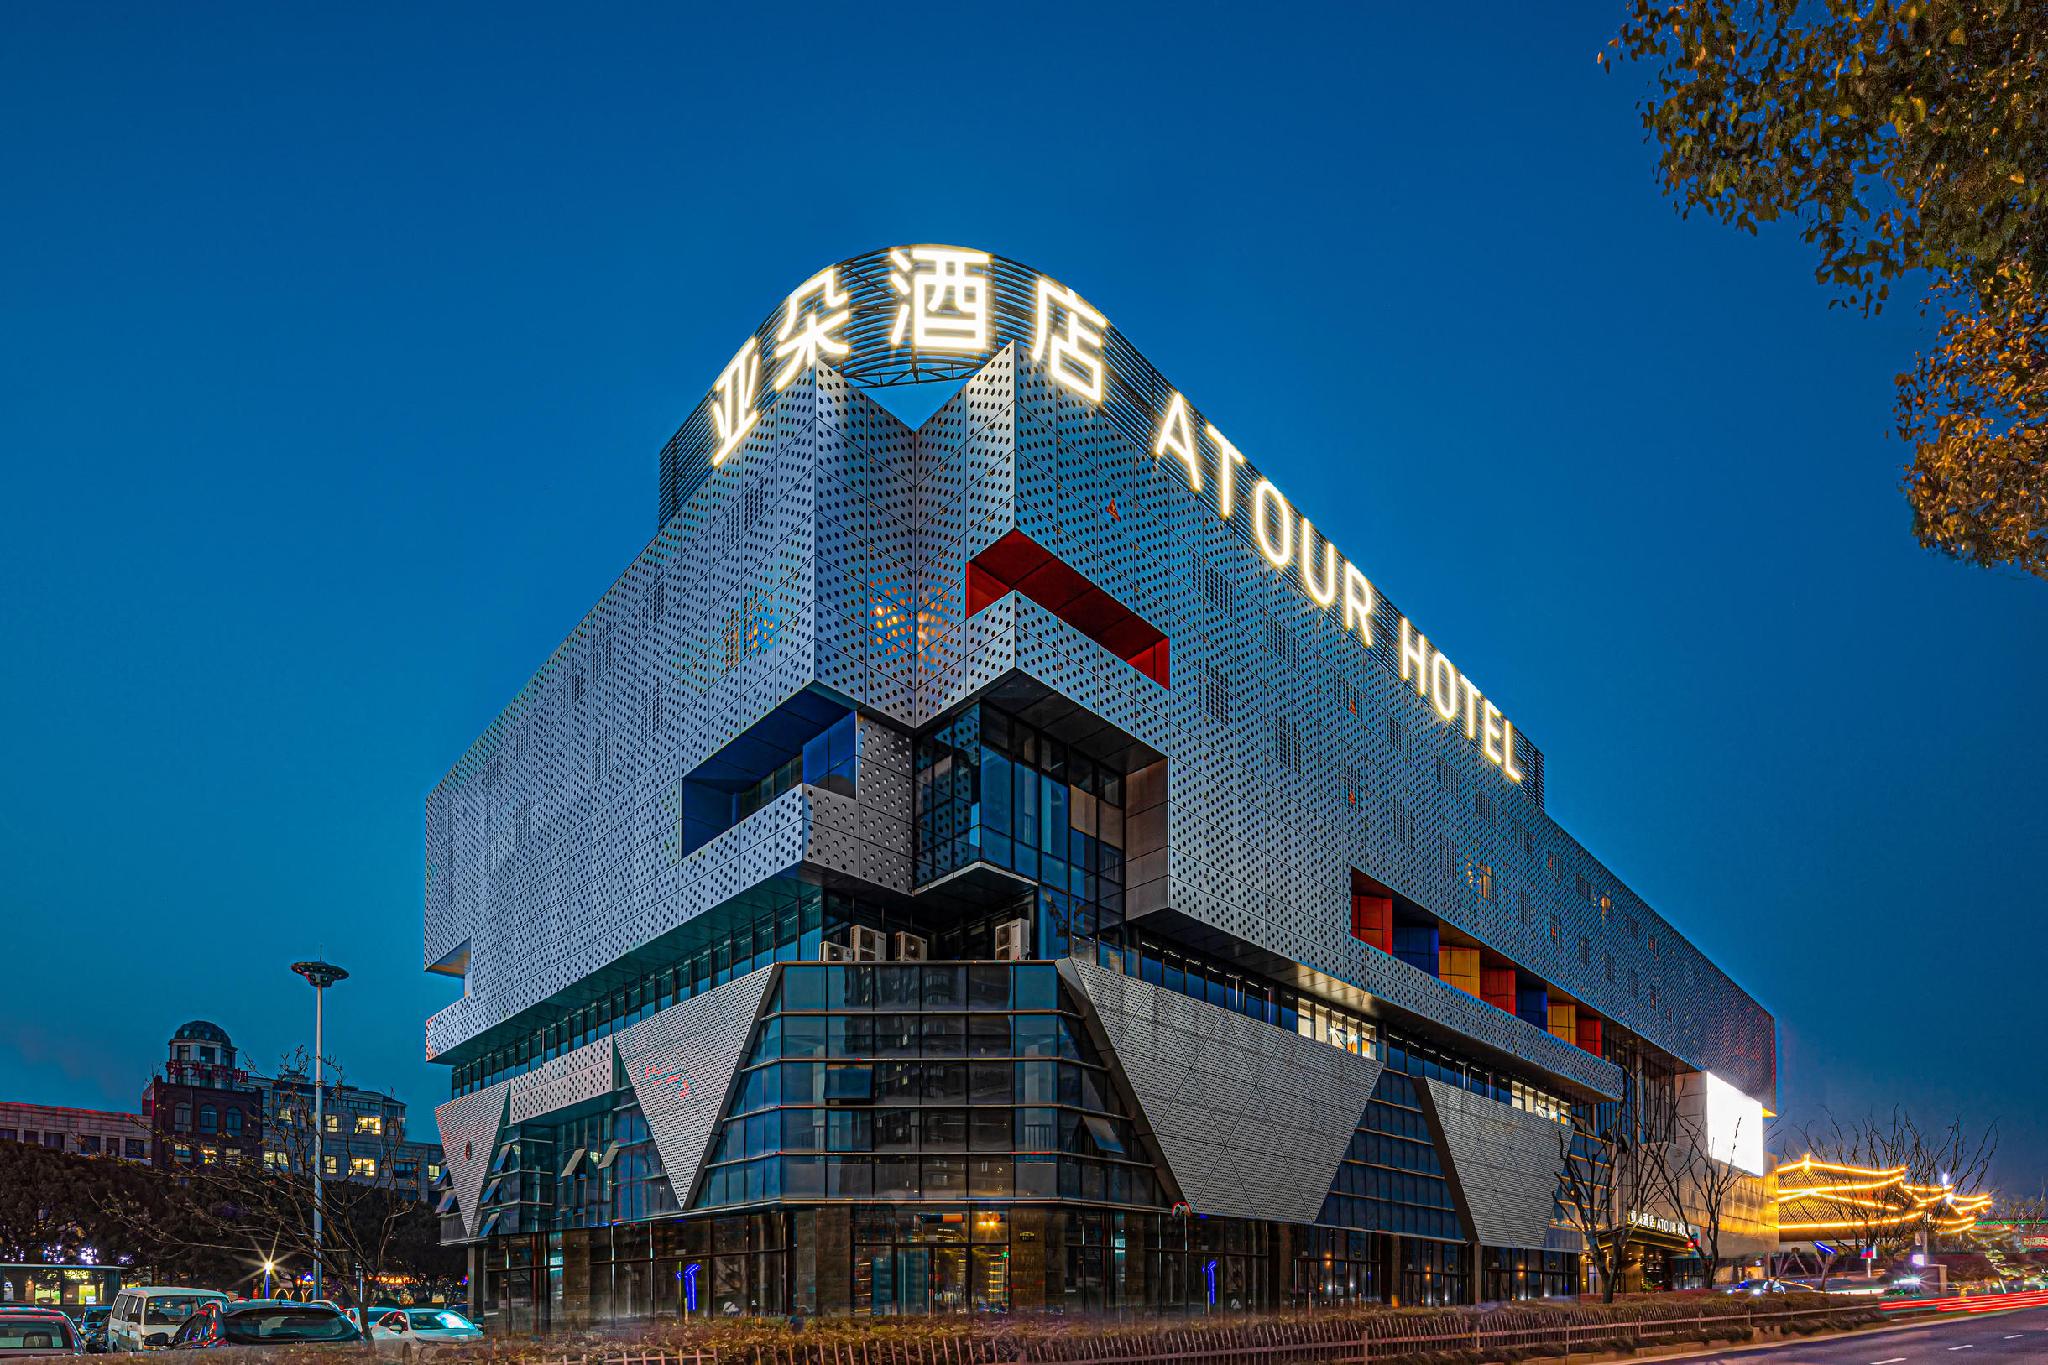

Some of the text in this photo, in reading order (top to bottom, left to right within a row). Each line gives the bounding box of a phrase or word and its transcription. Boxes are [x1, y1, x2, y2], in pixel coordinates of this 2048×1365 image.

[713, 247, 1524, 782] 亚朵酒店 ATOUR HOTEL
